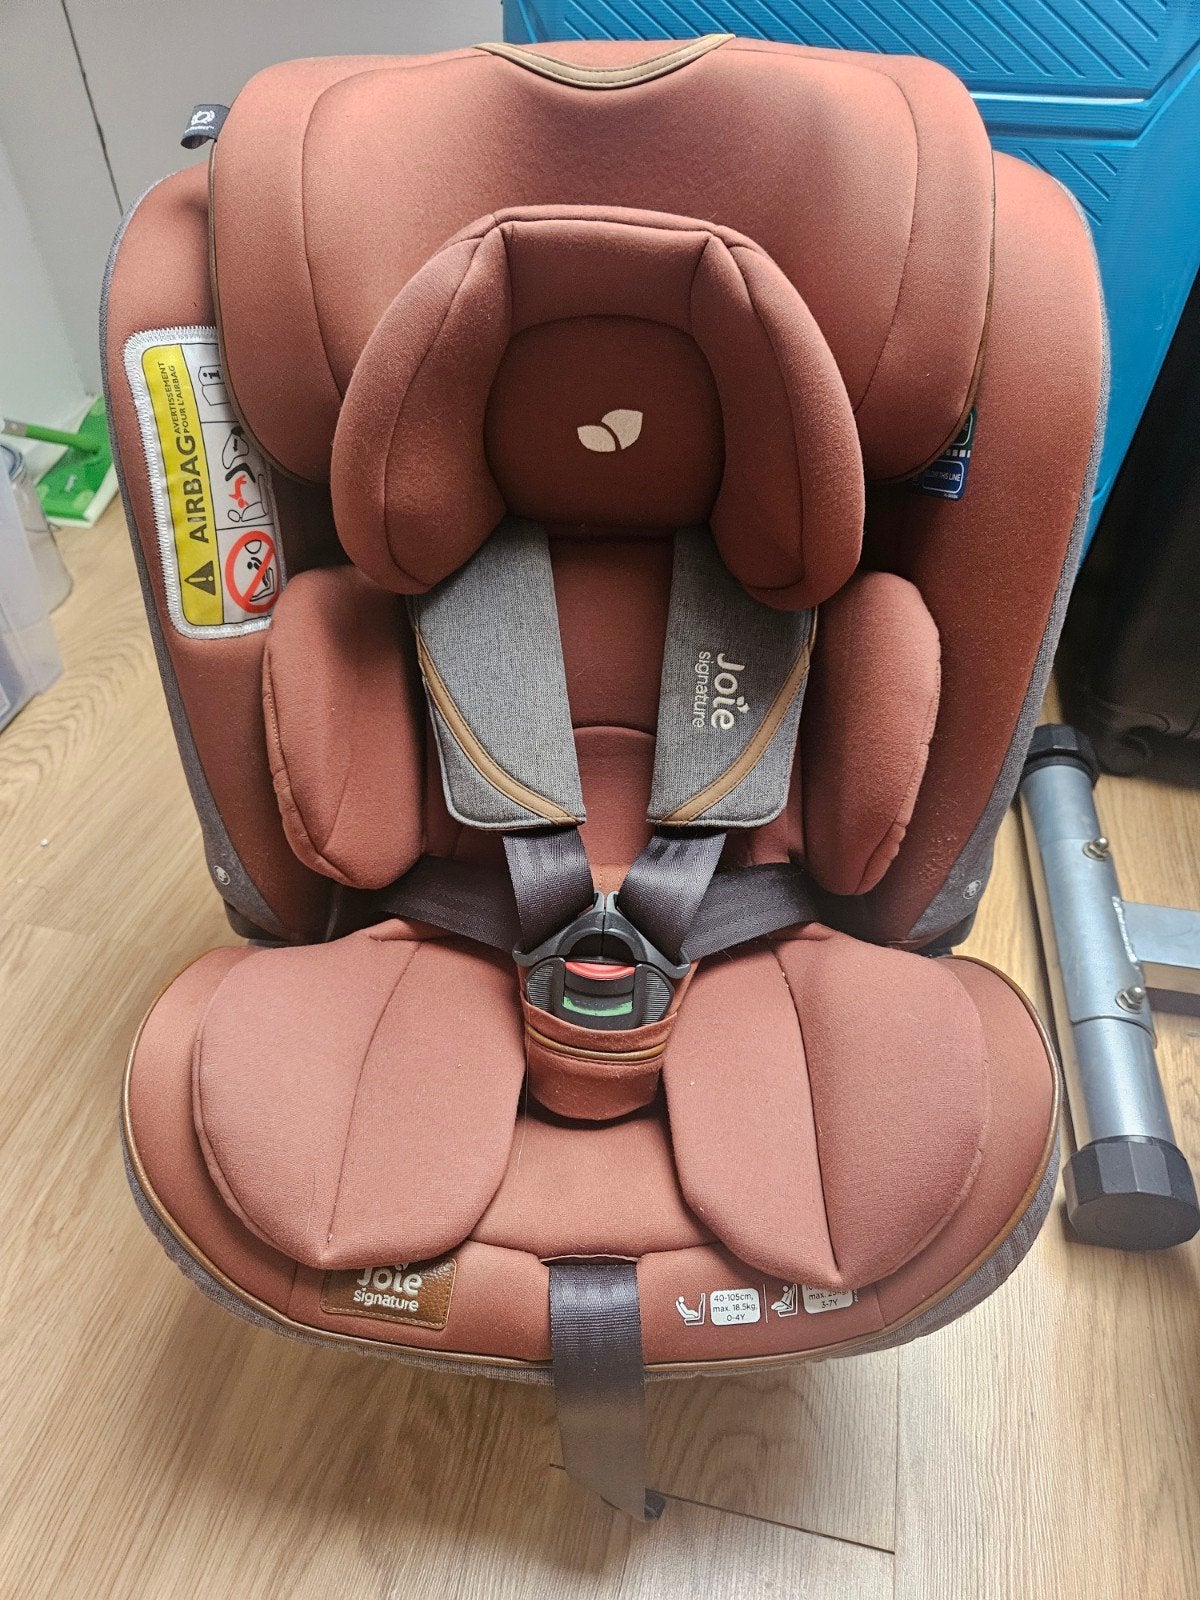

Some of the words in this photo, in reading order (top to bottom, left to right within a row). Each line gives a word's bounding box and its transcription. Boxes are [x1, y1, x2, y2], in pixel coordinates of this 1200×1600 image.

[157, 361, 182, 434] AVERTISSEMENT
[171, 365, 185, 406] L'AIRBAG
[180, 407, 191, 434] POUR
[176, 434, 210, 544] AIRBAG
[949, 473, 961, 481] LINE
[692, 651, 714, 728] signature
[711, 653, 746, 730] Joie
[353, 1287, 419, 1312] signature
[713, 1305, 731, 1313] max.
[821, 1299, 838, 1309] 3-7Y
[726, 1314, 746, 1322] 0-4Y
